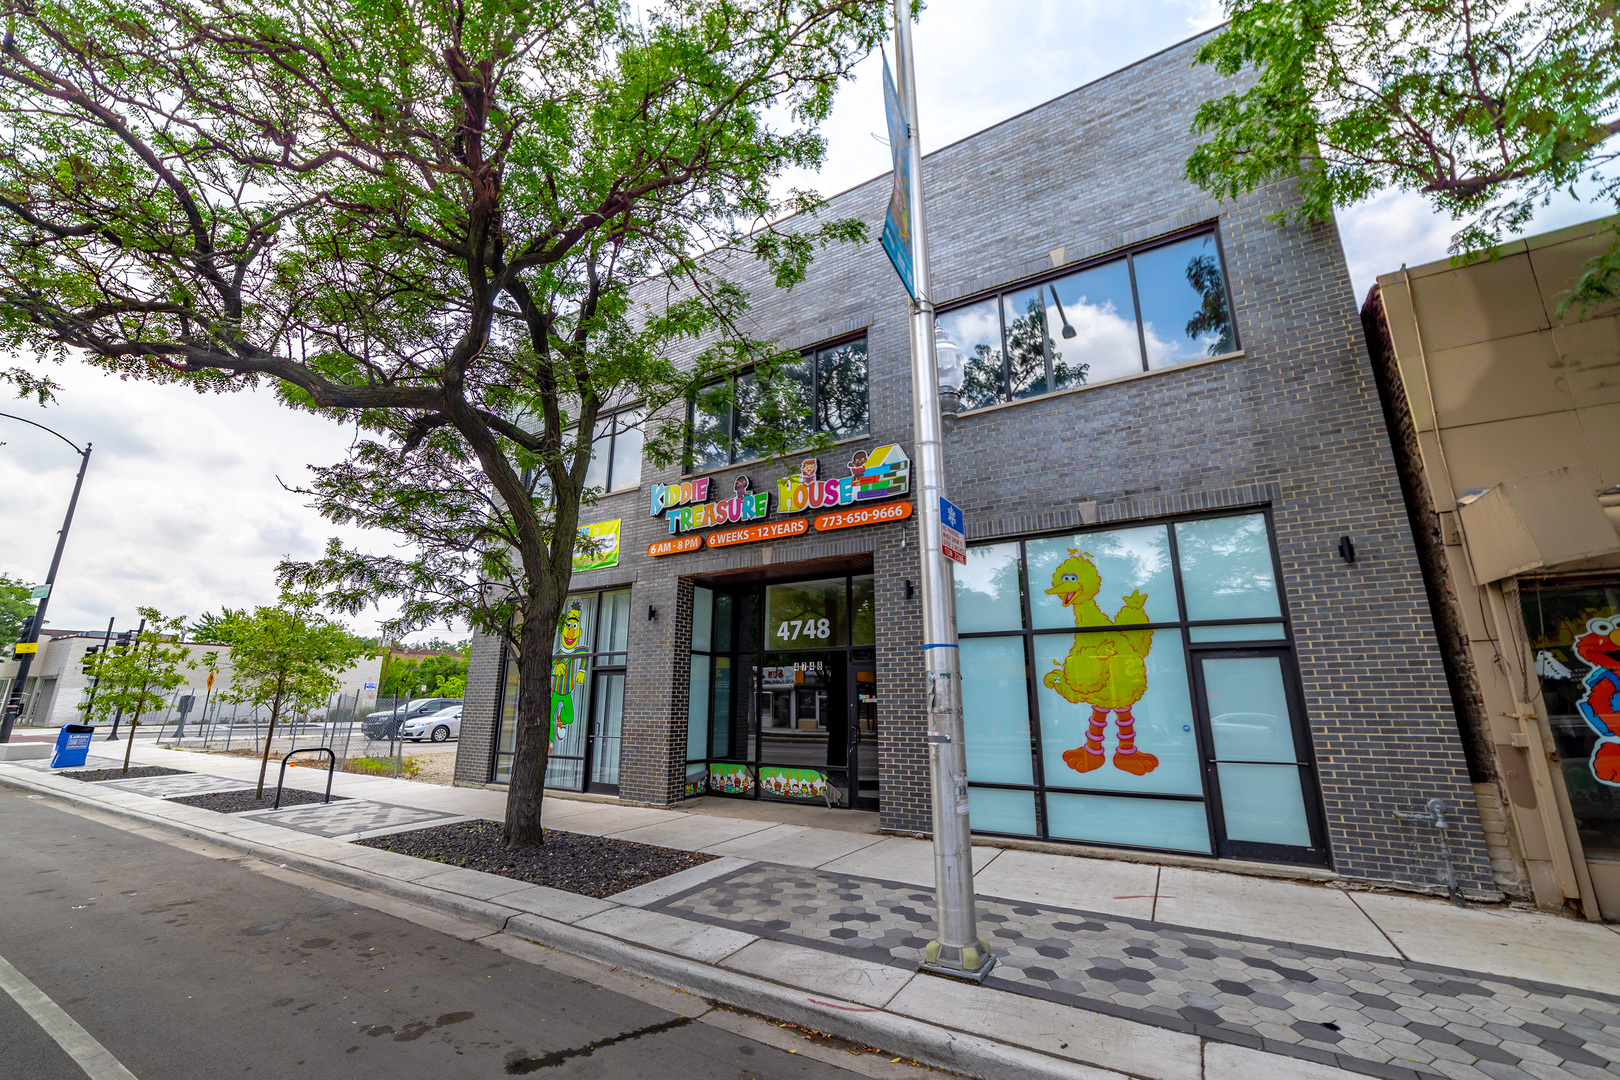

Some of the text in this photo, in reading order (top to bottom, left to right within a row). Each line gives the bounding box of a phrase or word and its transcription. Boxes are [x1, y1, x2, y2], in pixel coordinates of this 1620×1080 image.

[650, 477, 710, 515] KIDDIE
[666, 475, 854, 533] TREASURE HOUSE
[822, 506, 903, 528] 773-650-9666
[709, 536, 716, 545] 6
[717, 530, 749, 544] WEEKS
[758, 527, 769, 537] 12
[770, 521, 804, 535] YEARS
[650, 545, 656, 554] 6
[657, 543, 671, 553] AM
[677, 541, 683, 550] 8
[684, 538, 698, 548] PM
[944, 547, 965, 563] TOW ZONE
[776, 618, 831, 641] 4748
